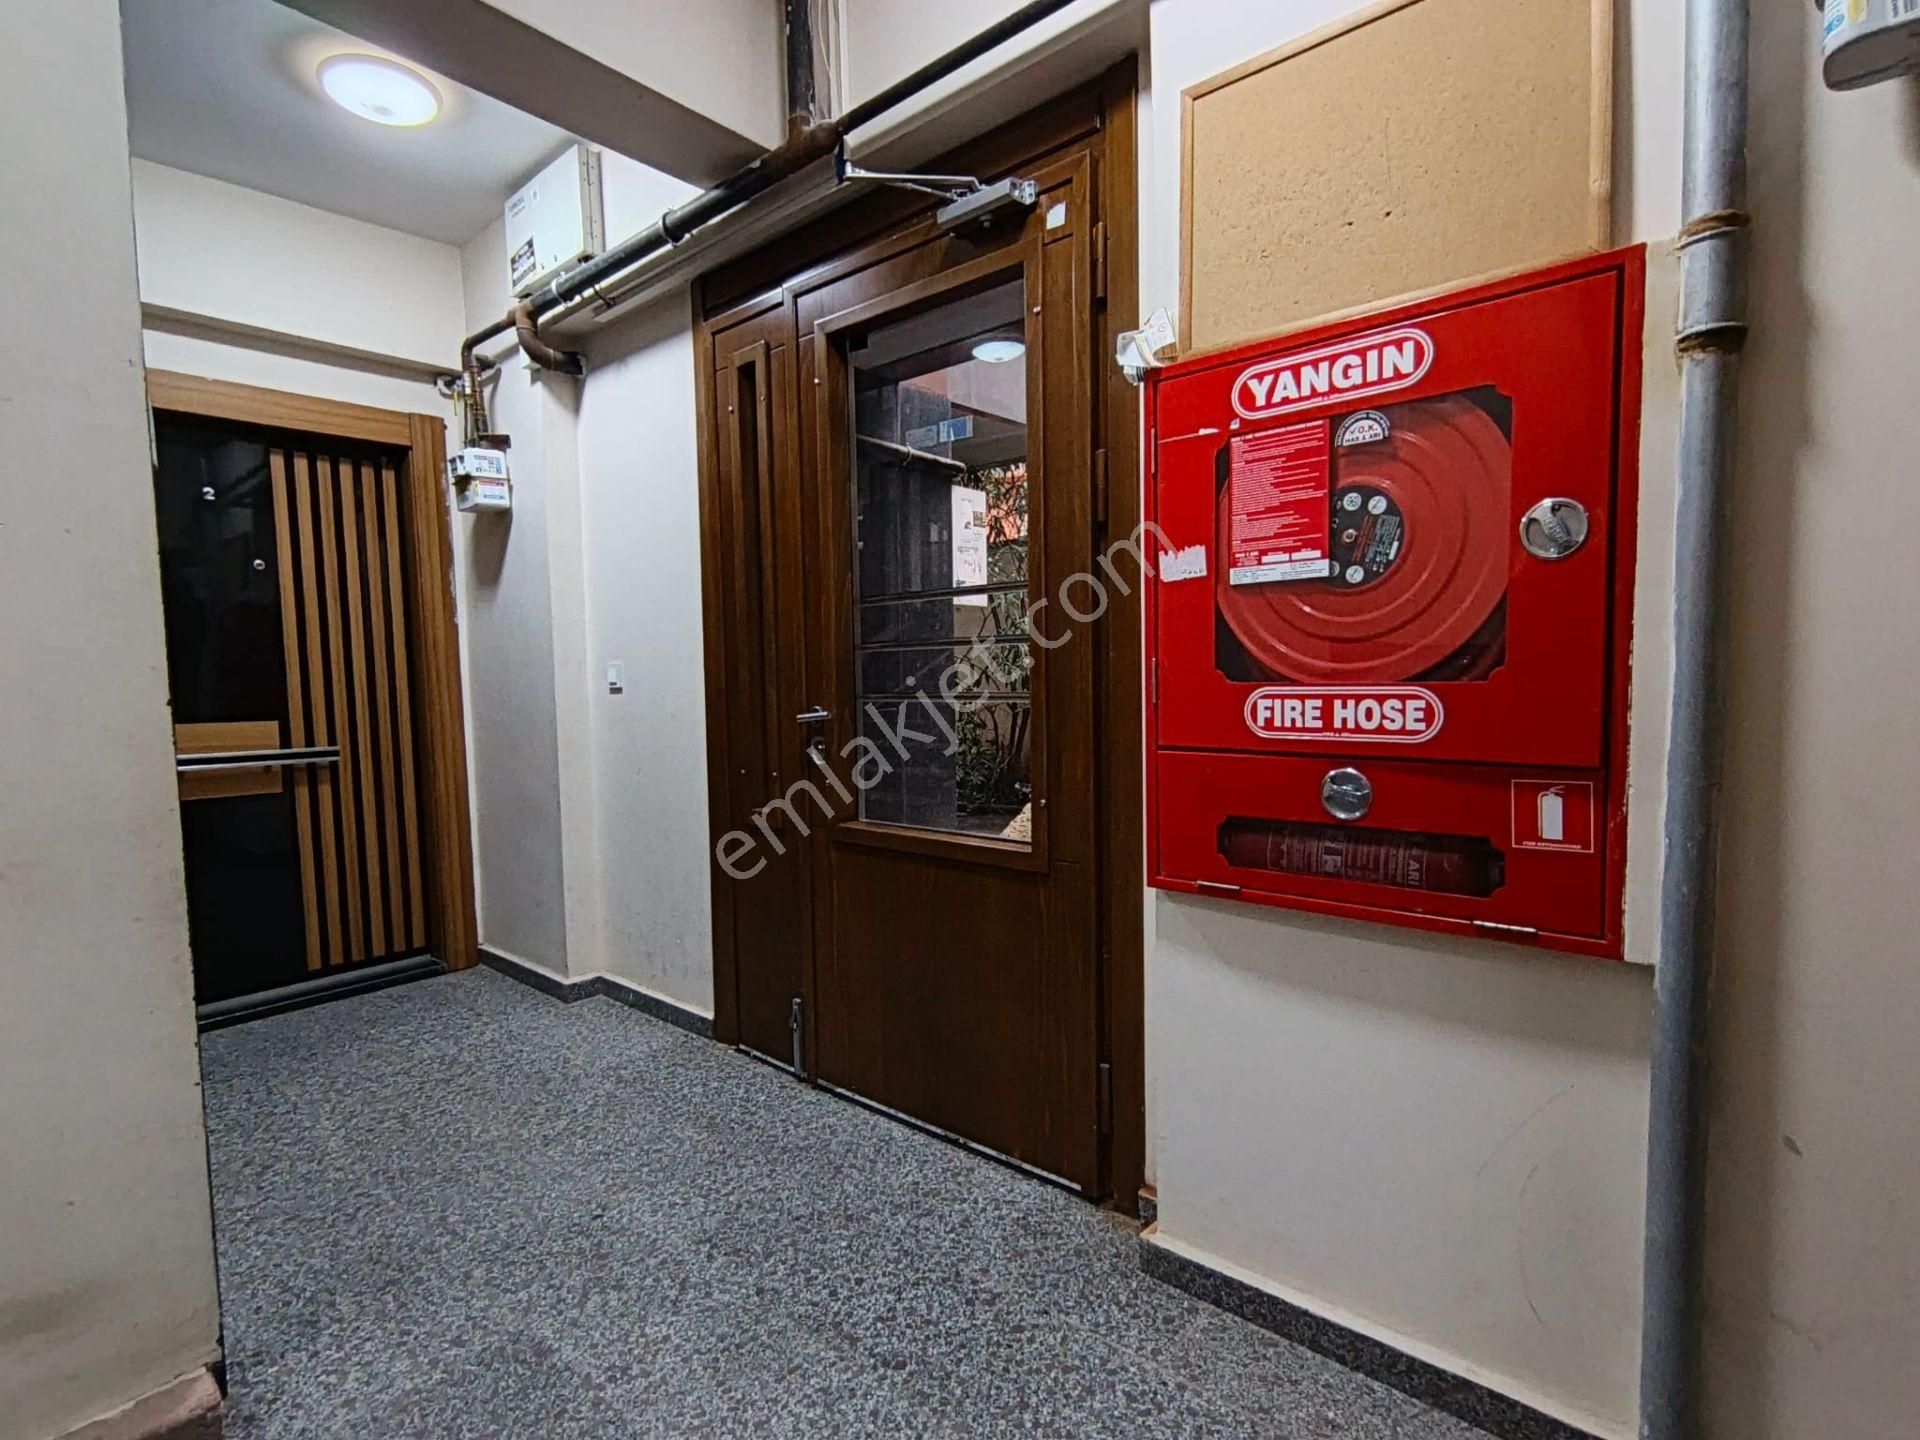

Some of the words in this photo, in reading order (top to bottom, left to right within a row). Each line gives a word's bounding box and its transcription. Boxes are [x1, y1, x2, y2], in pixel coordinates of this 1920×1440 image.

[1247, 340, 1415, 407] YANGIN
[1256, 698, 1323, 729] FIRE
[1333, 698, 1427, 731] HOSE
